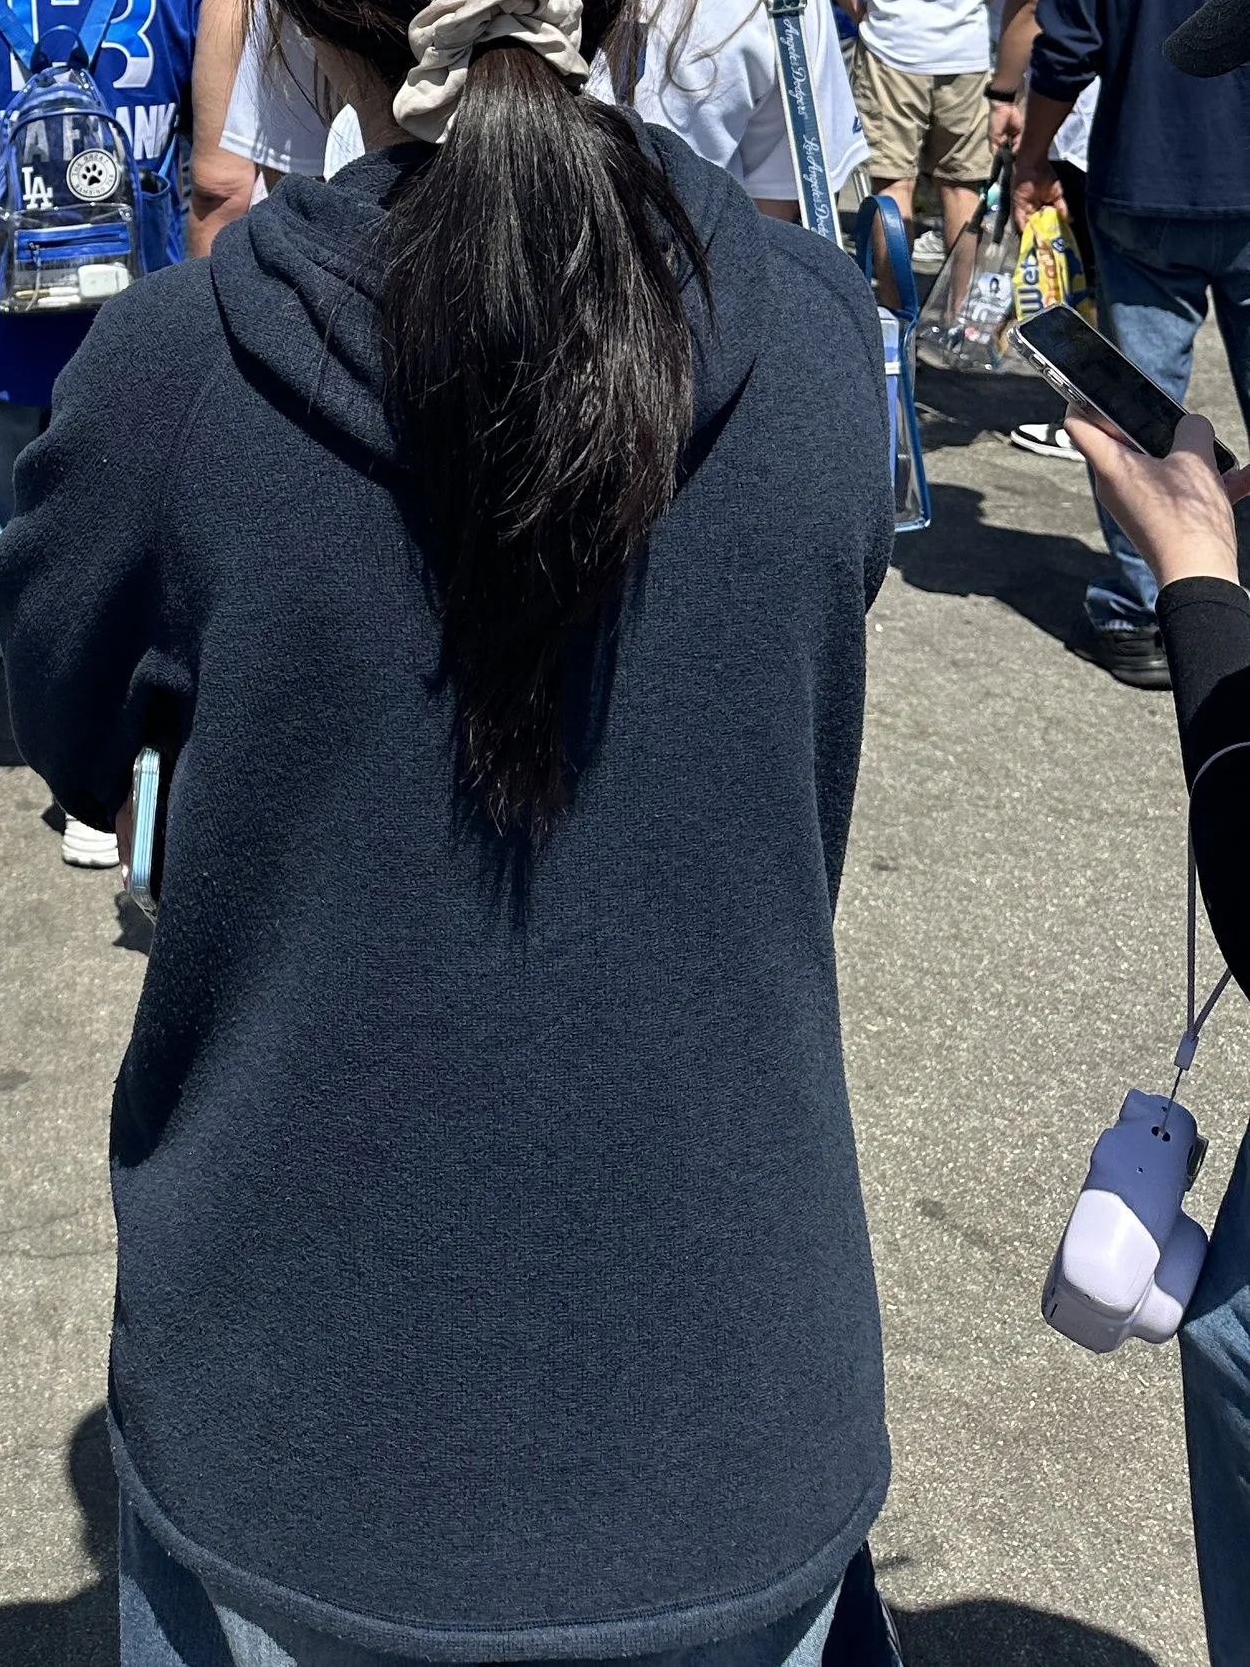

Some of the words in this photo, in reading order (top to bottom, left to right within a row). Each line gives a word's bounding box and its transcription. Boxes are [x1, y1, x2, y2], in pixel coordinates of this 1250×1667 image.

[779, 18, 801, 69] Angeles
[788, 66, 808, 120] Dodgers
[802, 134, 817, 156] Los
[21, 167, 53, 210] LA
[803, 152, 823, 202] Angeles
[810, 199, 830, 238] Dodg
